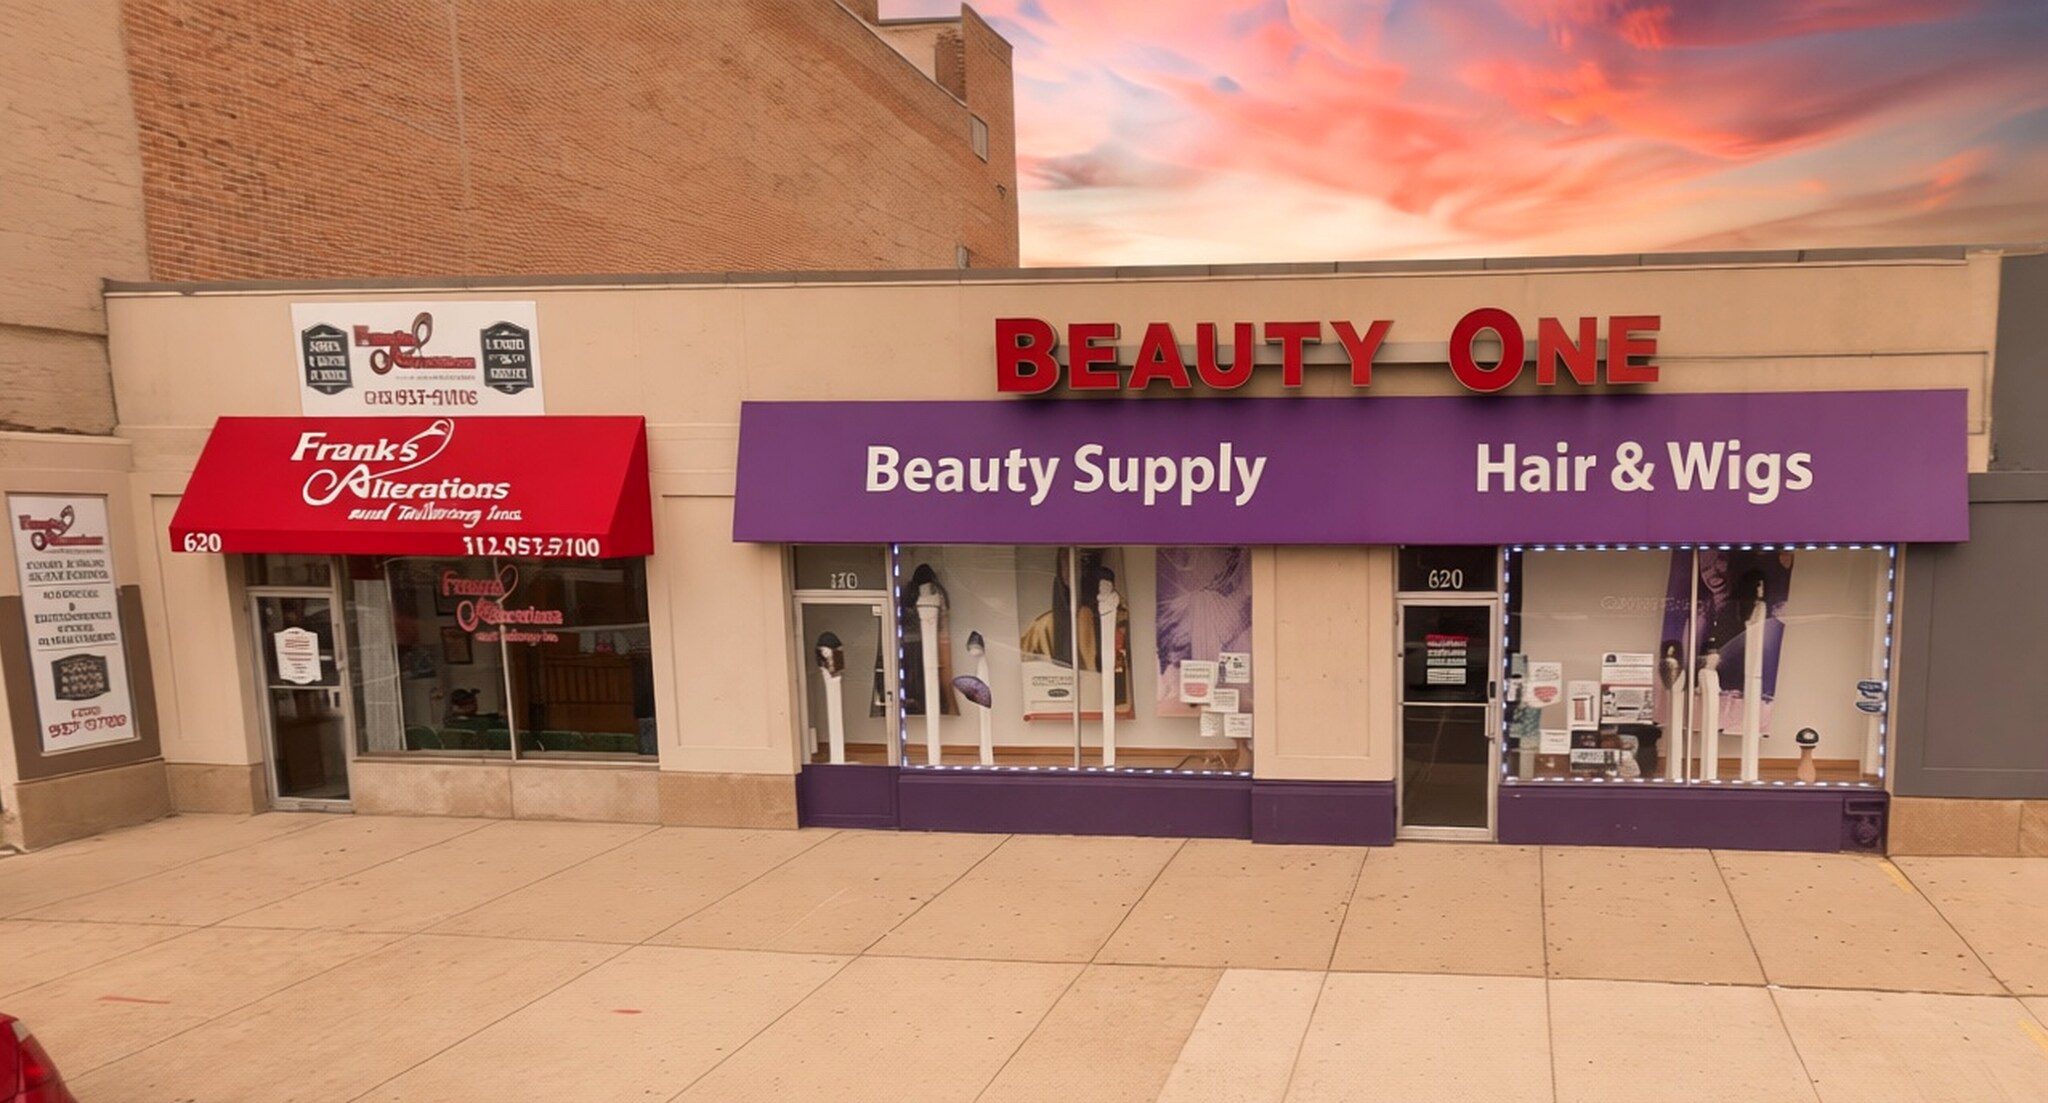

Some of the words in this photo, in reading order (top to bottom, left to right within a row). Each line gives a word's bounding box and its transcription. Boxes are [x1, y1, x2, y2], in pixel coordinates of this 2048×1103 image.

[995, 318, 1395, 395] BEAUTY
[1448, 307, 1661, 392] ONE
[865, 445, 1060, 506] Beauty
[1073, 442, 1267, 506] Supply
[1476, 441, 1597, 493] Hair
[1611, 441, 1654, 493] &
[1667, 439, 1814, 505] Wigs
[184, 532, 222, 552] 620
[1428, 569, 1463, 589] 620
